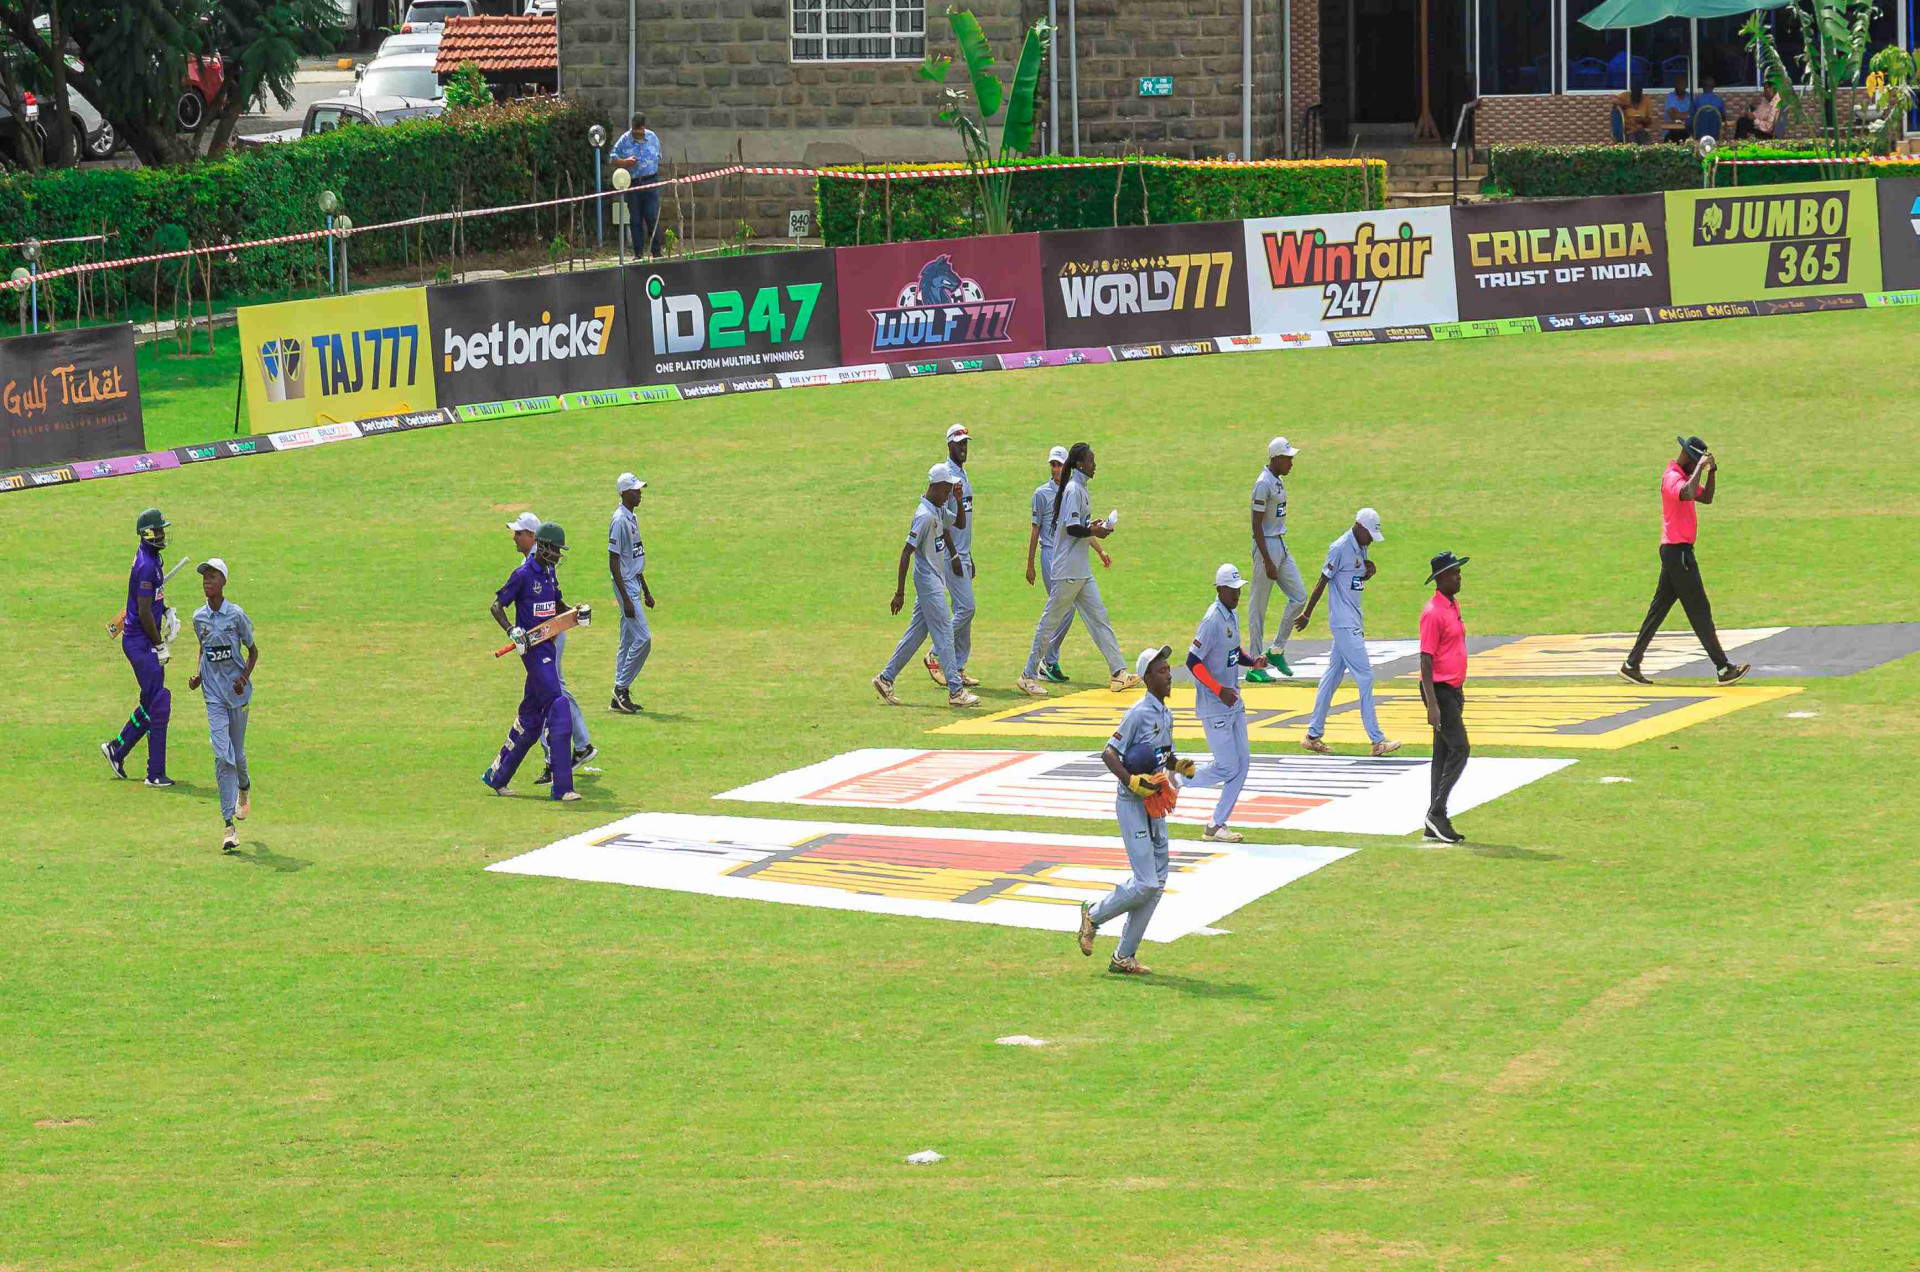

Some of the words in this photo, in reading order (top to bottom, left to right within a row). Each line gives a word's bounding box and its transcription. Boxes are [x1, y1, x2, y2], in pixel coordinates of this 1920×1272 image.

[791, 214, 810, 227] 840
[1725, 197, 1844, 240] JUMBO
[1263, 224, 1431, 288] Winfair
[1467, 222, 1653, 267] CRICADDA
[1777, 243, 1842, 284] 365
[1474, 269, 1550, 289] TRUST
[1553, 266, 1586, 284] OF
[1590, 262, 1654, 281] INDIA
[1325, 280, 1382, 318] 247
[655, 362, 675, 374] ONE
[675, 358, 721, 372] PLATFORM
[721, 354, 761, 368] MULTIPLE
[762, 350, 805, 363] WINNINGS
[3, 375, 48, 419] Gulf
